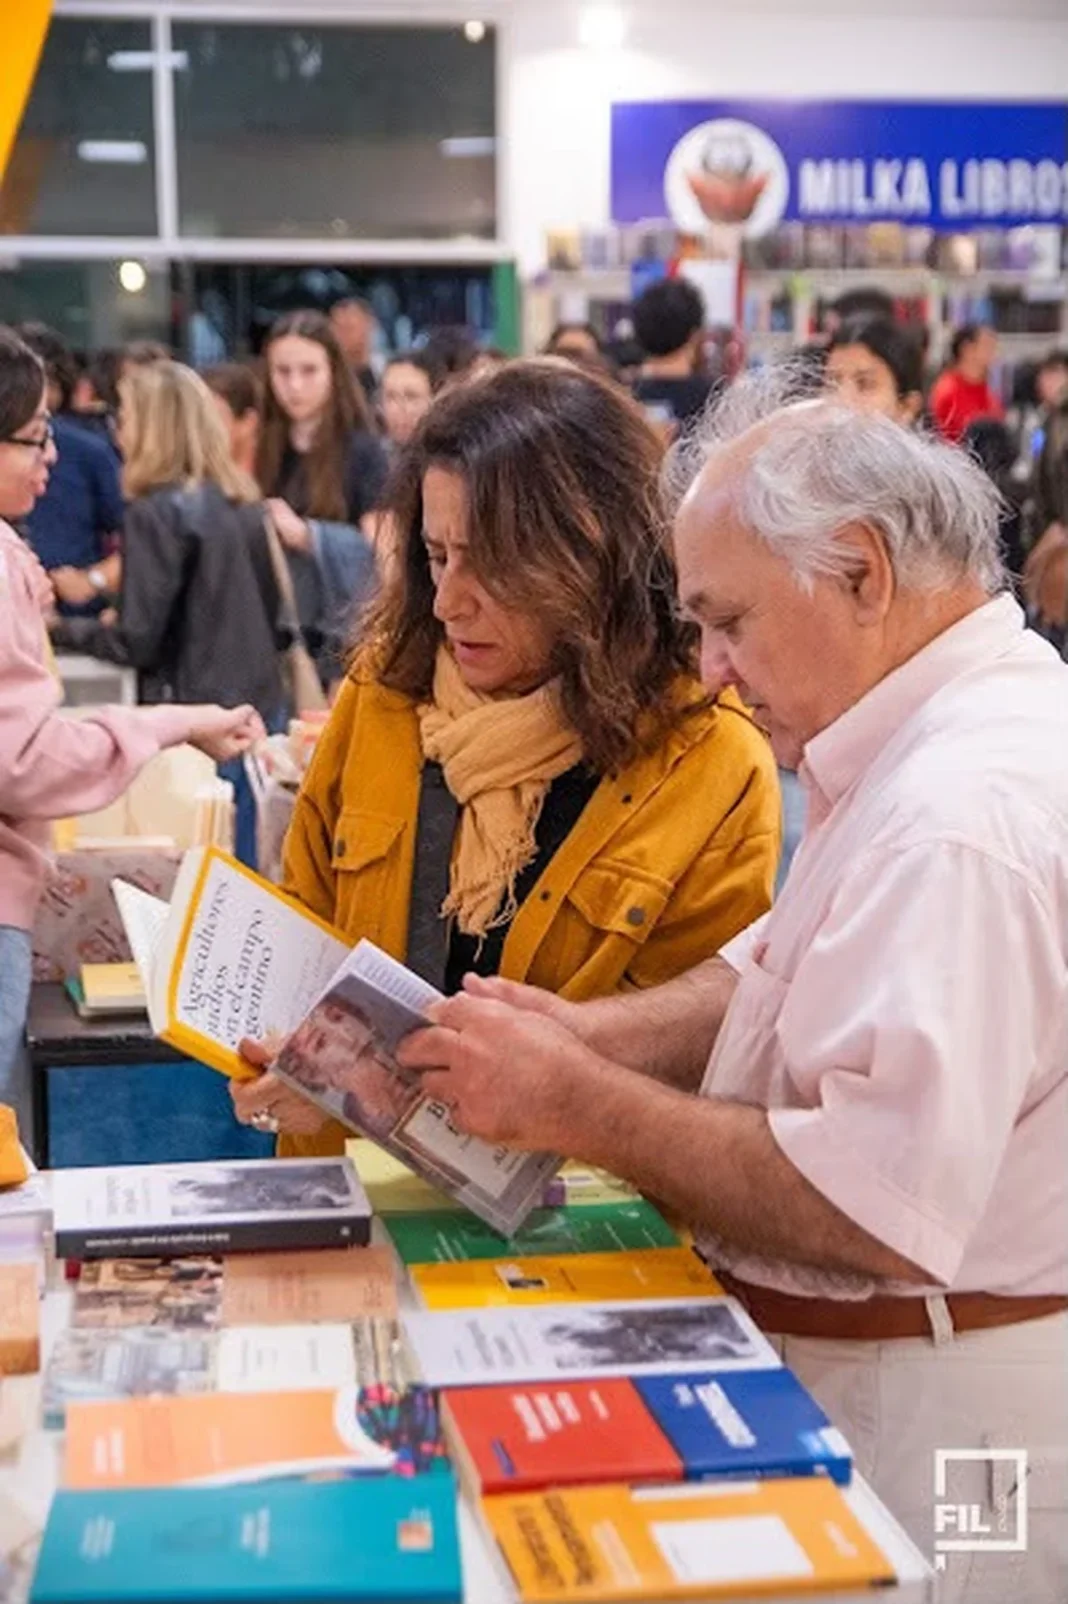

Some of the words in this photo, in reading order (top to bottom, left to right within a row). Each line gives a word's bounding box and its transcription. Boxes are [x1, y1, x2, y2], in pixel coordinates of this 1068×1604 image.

[799, 157, 931, 217] MILKA
[183, 881, 229, 1015] Agricultores
[235, 909, 263, 989] campo
[246, 945, 274, 1040] gentino
